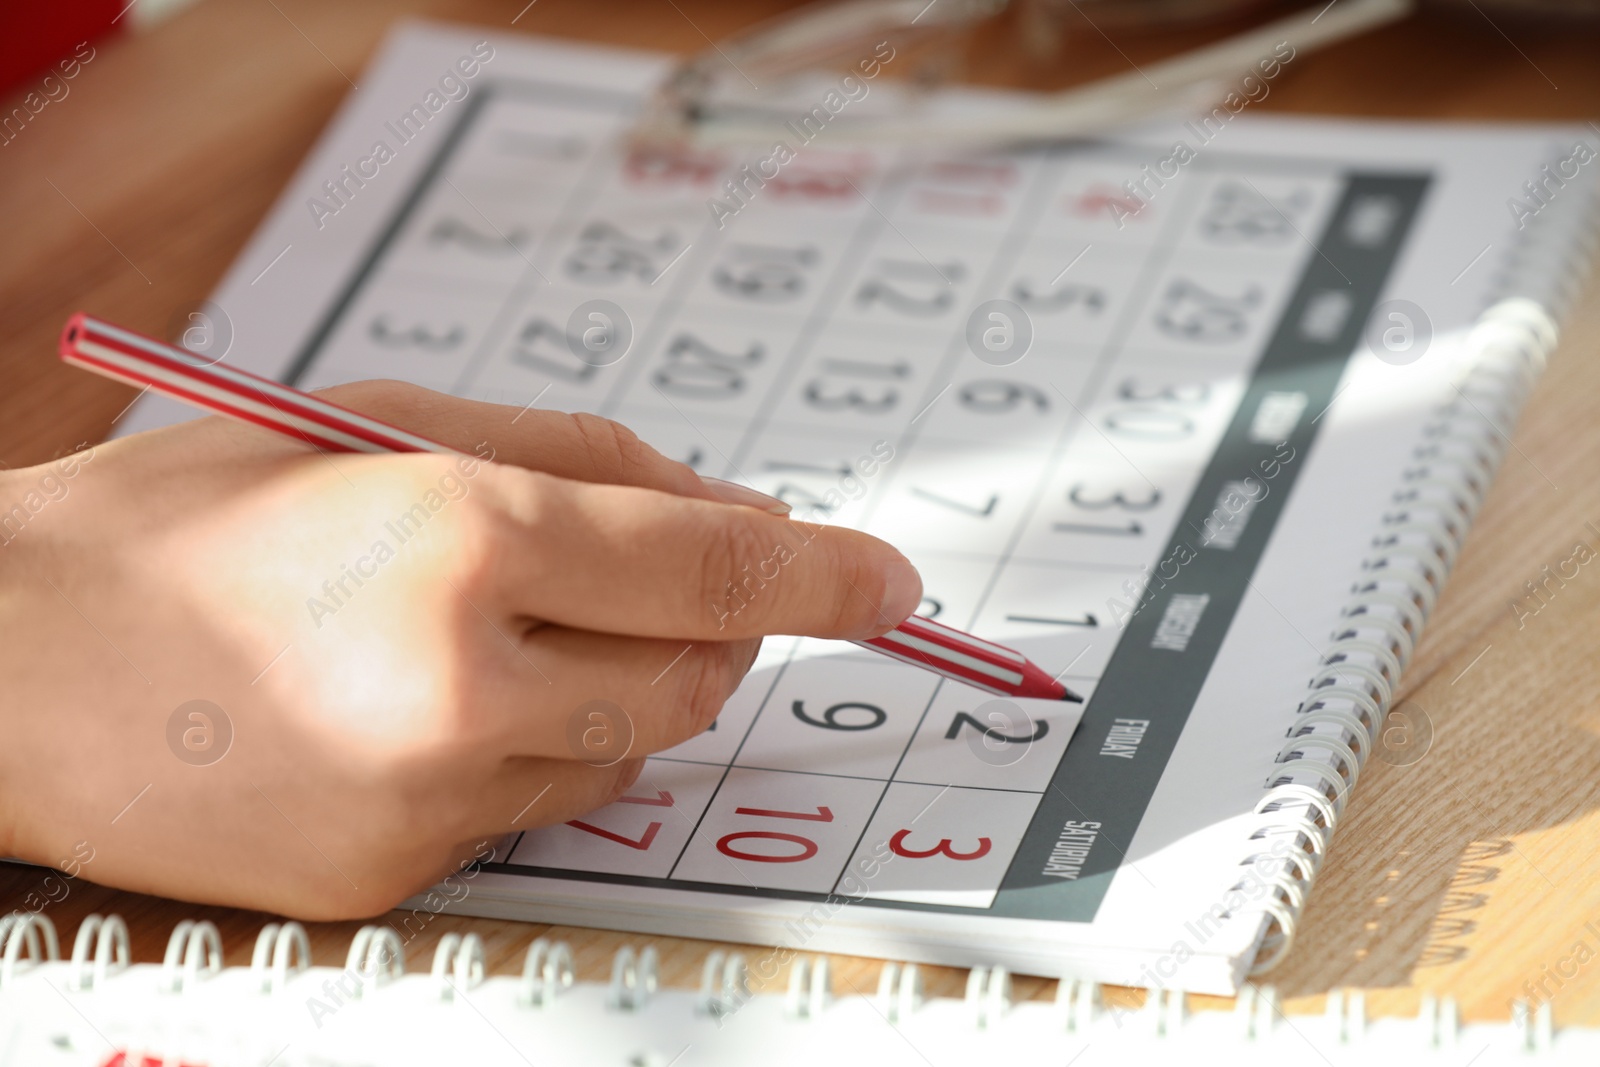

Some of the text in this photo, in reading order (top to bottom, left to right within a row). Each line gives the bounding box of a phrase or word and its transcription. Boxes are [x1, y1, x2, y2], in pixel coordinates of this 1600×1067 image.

[856, 261, 966, 318] 12
[1011, 276, 1105, 313] 5
[1155, 278, 1262, 343] 29
[368, 317, 464, 353] 3
[652, 334, 765, 398] 20
[805, 359, 911, 414] 13
[958, 378, 1051, 414] 6
[1104, 379, 1211, 442] 30
[911, 487, 999, 518] 7
[1052, 483, 1162, 536] 31
[1007, 612, 1098, 628] 1
[792, 700, 887, 732] 9
[944, 711, 1050, 745] 2
[1100, 718, 1150, 759] FRIDAY
[566, 790, 675, 851] 17
[716, 806, 835, 864] 10
[888, 829, 993, 862] 3
[1042, 820, 1102, 880] SATURDAY
